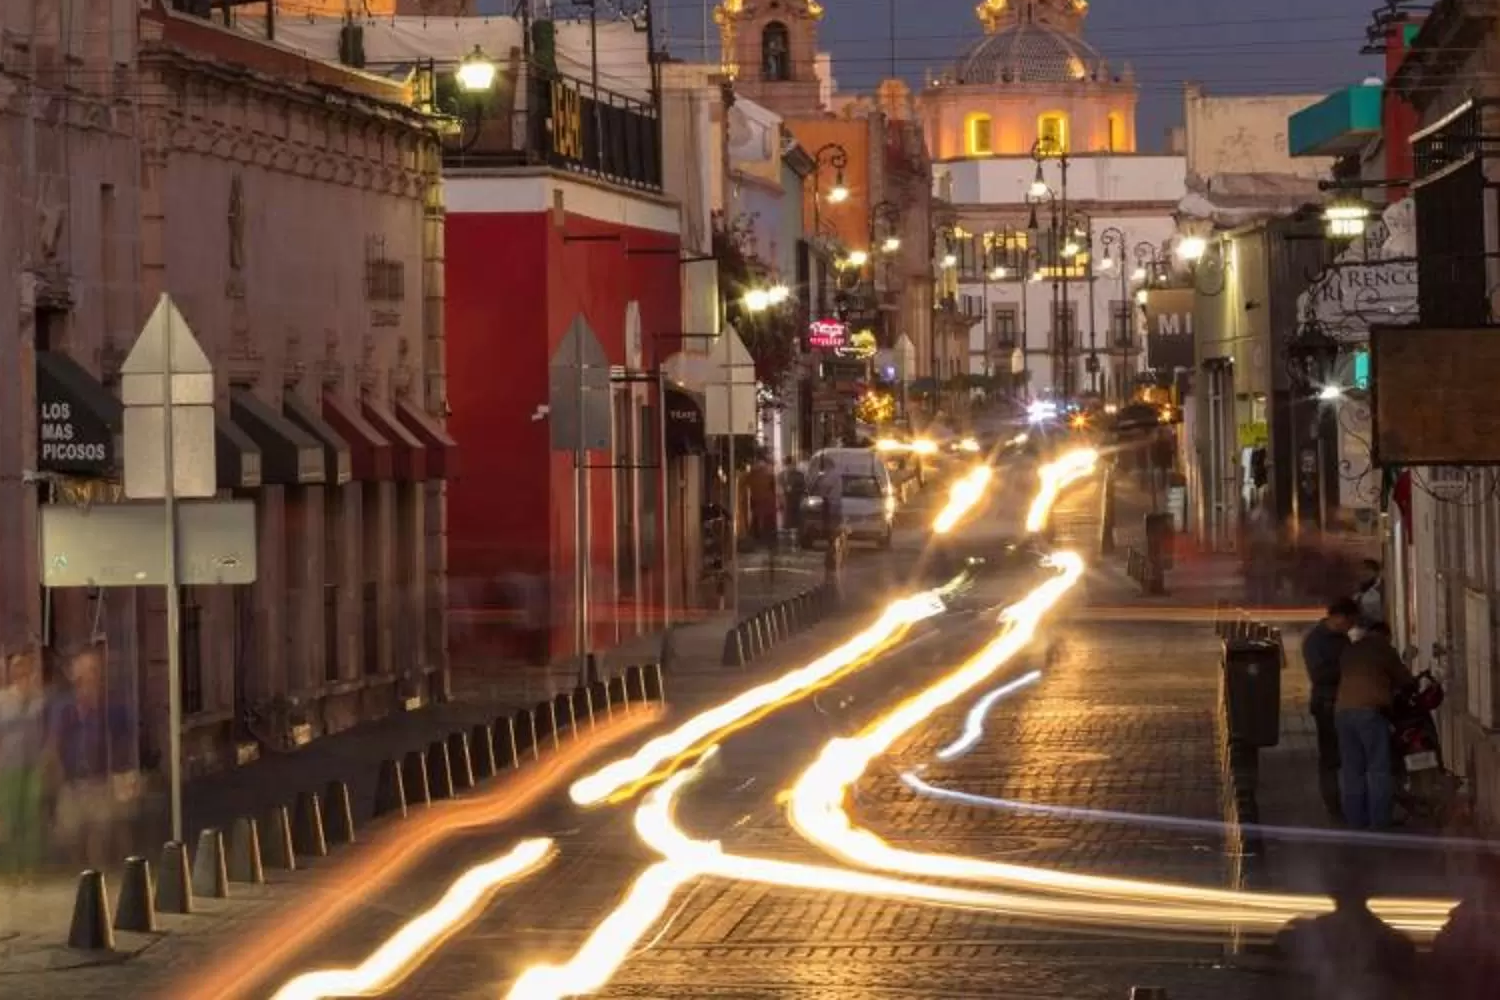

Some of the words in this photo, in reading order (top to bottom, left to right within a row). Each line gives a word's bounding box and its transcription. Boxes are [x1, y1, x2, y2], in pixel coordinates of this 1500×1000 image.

[41, 402, 70, 420] LOS
[41, 423, 74, 441] MAS
[42, 443, 106, 461] PICOSOS
